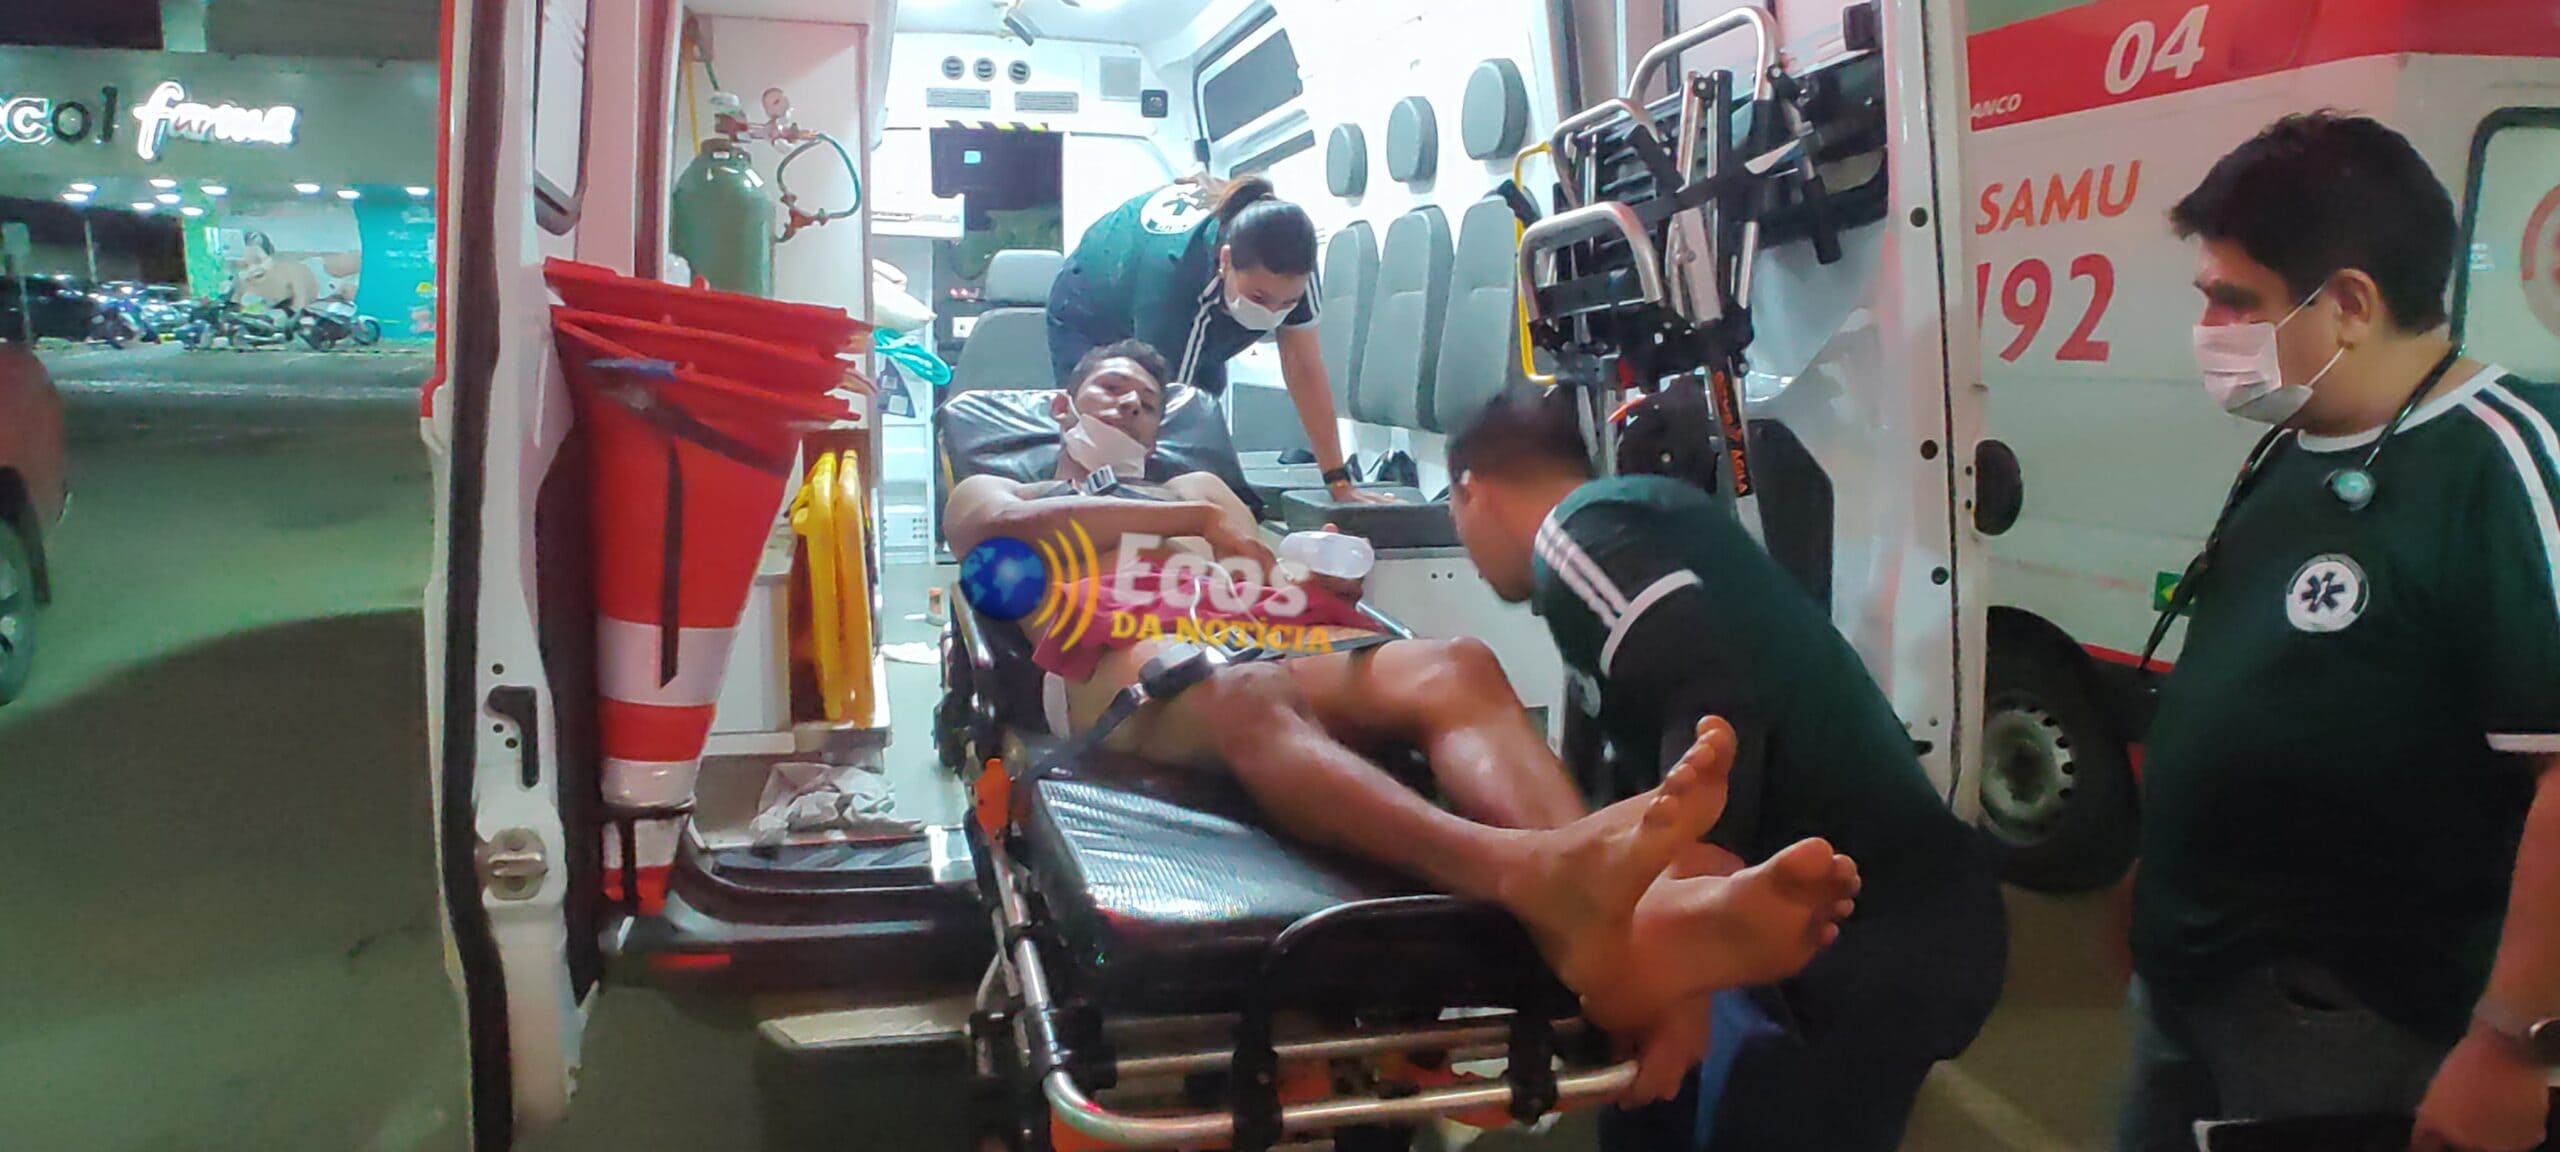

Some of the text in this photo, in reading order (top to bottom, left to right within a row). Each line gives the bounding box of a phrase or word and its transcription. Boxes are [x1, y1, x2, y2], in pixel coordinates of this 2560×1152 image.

[2104, 6, 2208, 95] 04
[0, 86, 118, 143] col
[1975, 159, 2143, 235] SAMU
